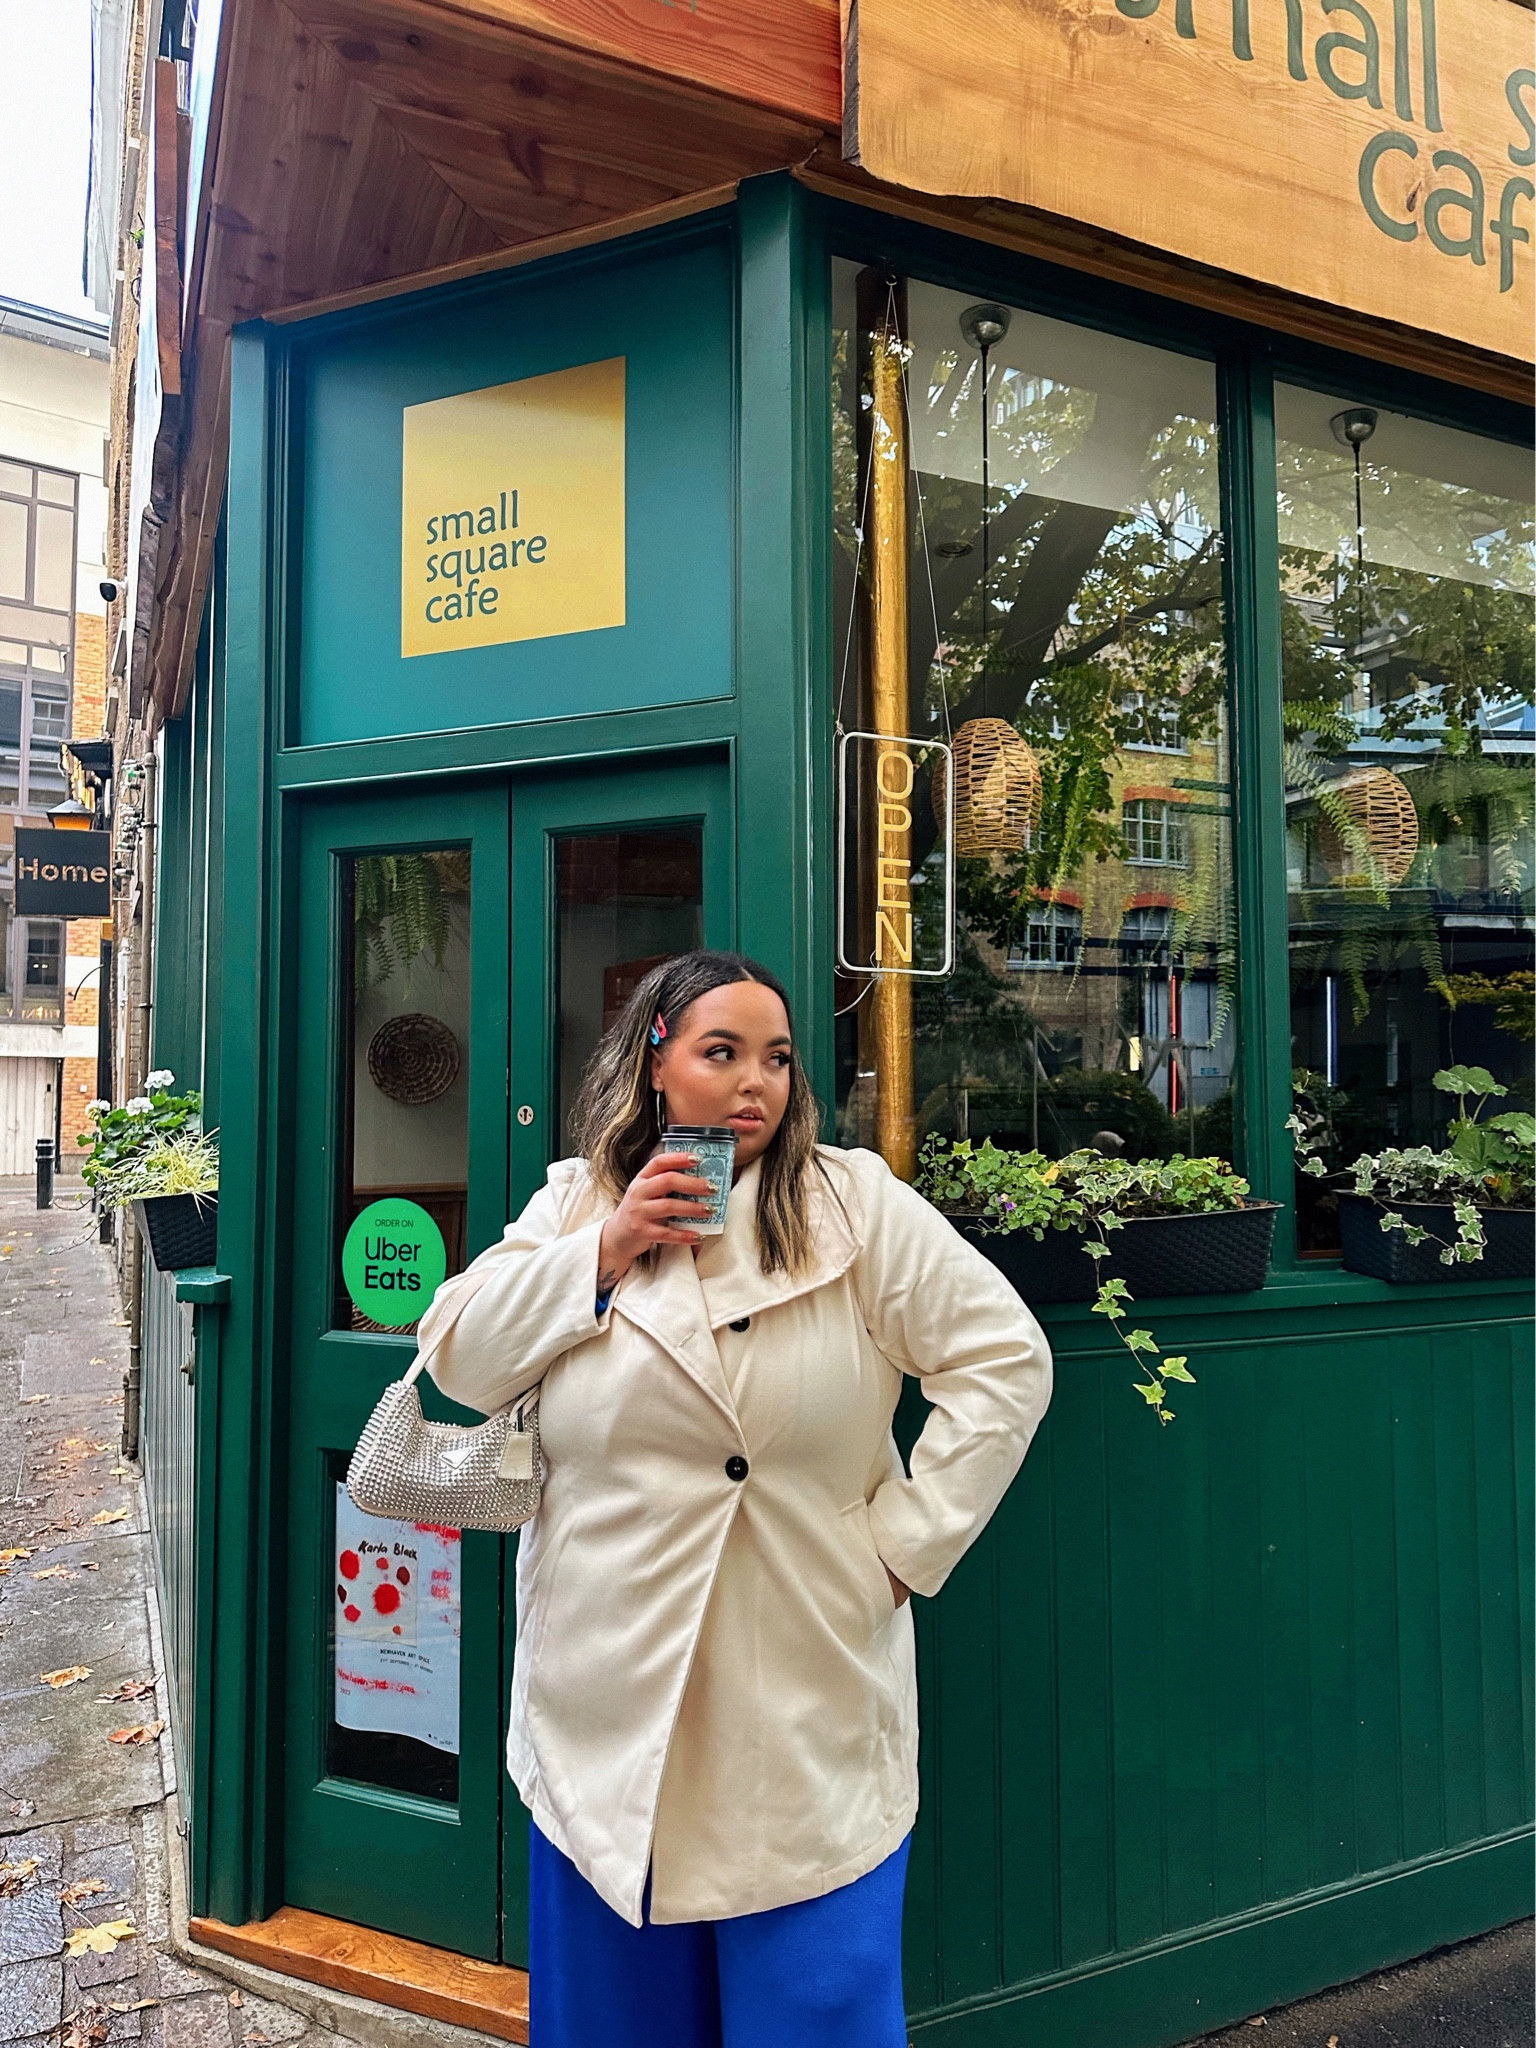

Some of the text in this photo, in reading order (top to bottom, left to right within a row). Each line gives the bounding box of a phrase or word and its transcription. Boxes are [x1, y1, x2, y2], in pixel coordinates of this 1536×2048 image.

[1114, 0, 1444, 133] mall
[426, 489, 519, 545] small
[426, 535, 547, 588] square
[425, 578, 499, 624] cafe
[875, 750, 914, 963] OPEN
[18, 857, 108, 884] Home
[374, 1218, 414, 1228] ORDER ON
[365, 1236, 422, 1262] Uber
[364, 1265, 422, 1292] Eats
[358, 1540, 418, 1560] Karla Black
[379, 1648, 406, 1657] NEWHAVEN
[418, 1655, 430, 1664] SPACE
